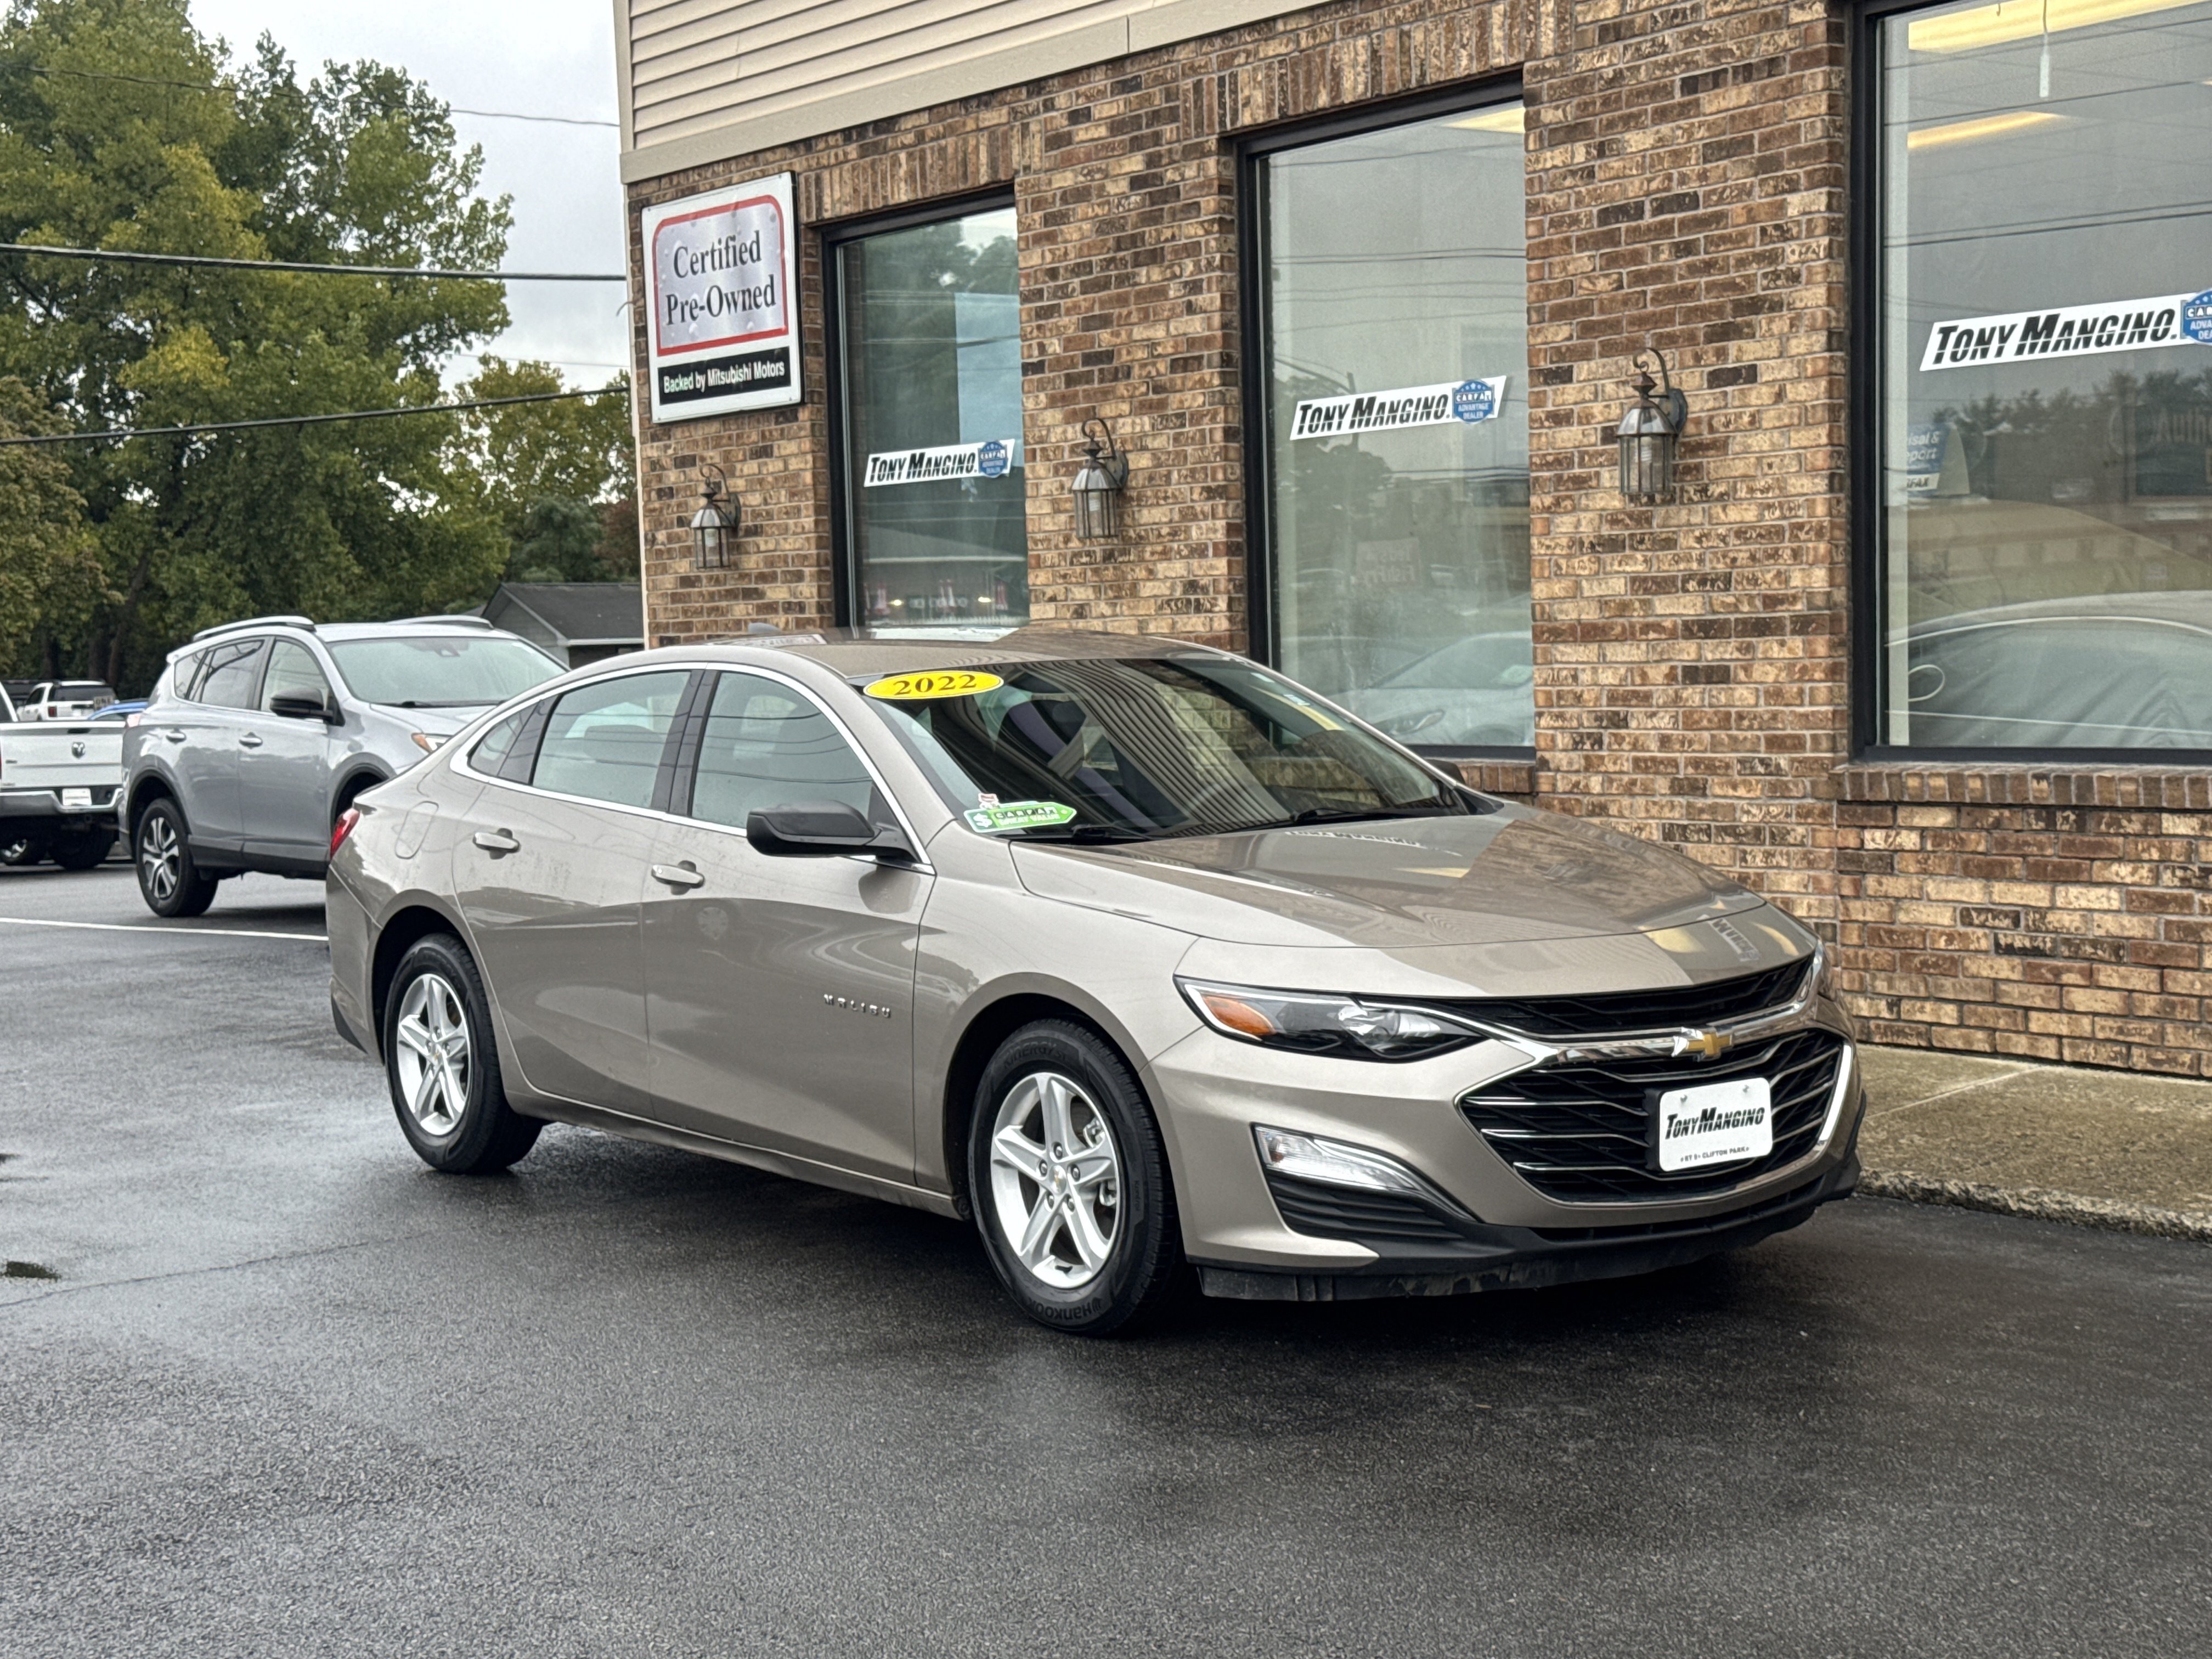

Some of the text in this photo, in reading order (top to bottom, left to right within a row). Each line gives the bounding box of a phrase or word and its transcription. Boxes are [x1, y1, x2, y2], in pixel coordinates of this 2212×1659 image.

[674, 230, 761, 278] Certified
[666, 275, 776, 325] Pre-Owned
[1932, 324, 2018, 365] TONY
[663, 360, 785, 393] Backed by Mitsubishi Motors
[1297, 403, 1350, 435] TONY
[870, 456, 907, 483] TONY
[893, 674, 977, 696] 2022
[823, 994, 891, 1018] MALIBU
[1702, 1149, 1728, 1159] CLIFTON
